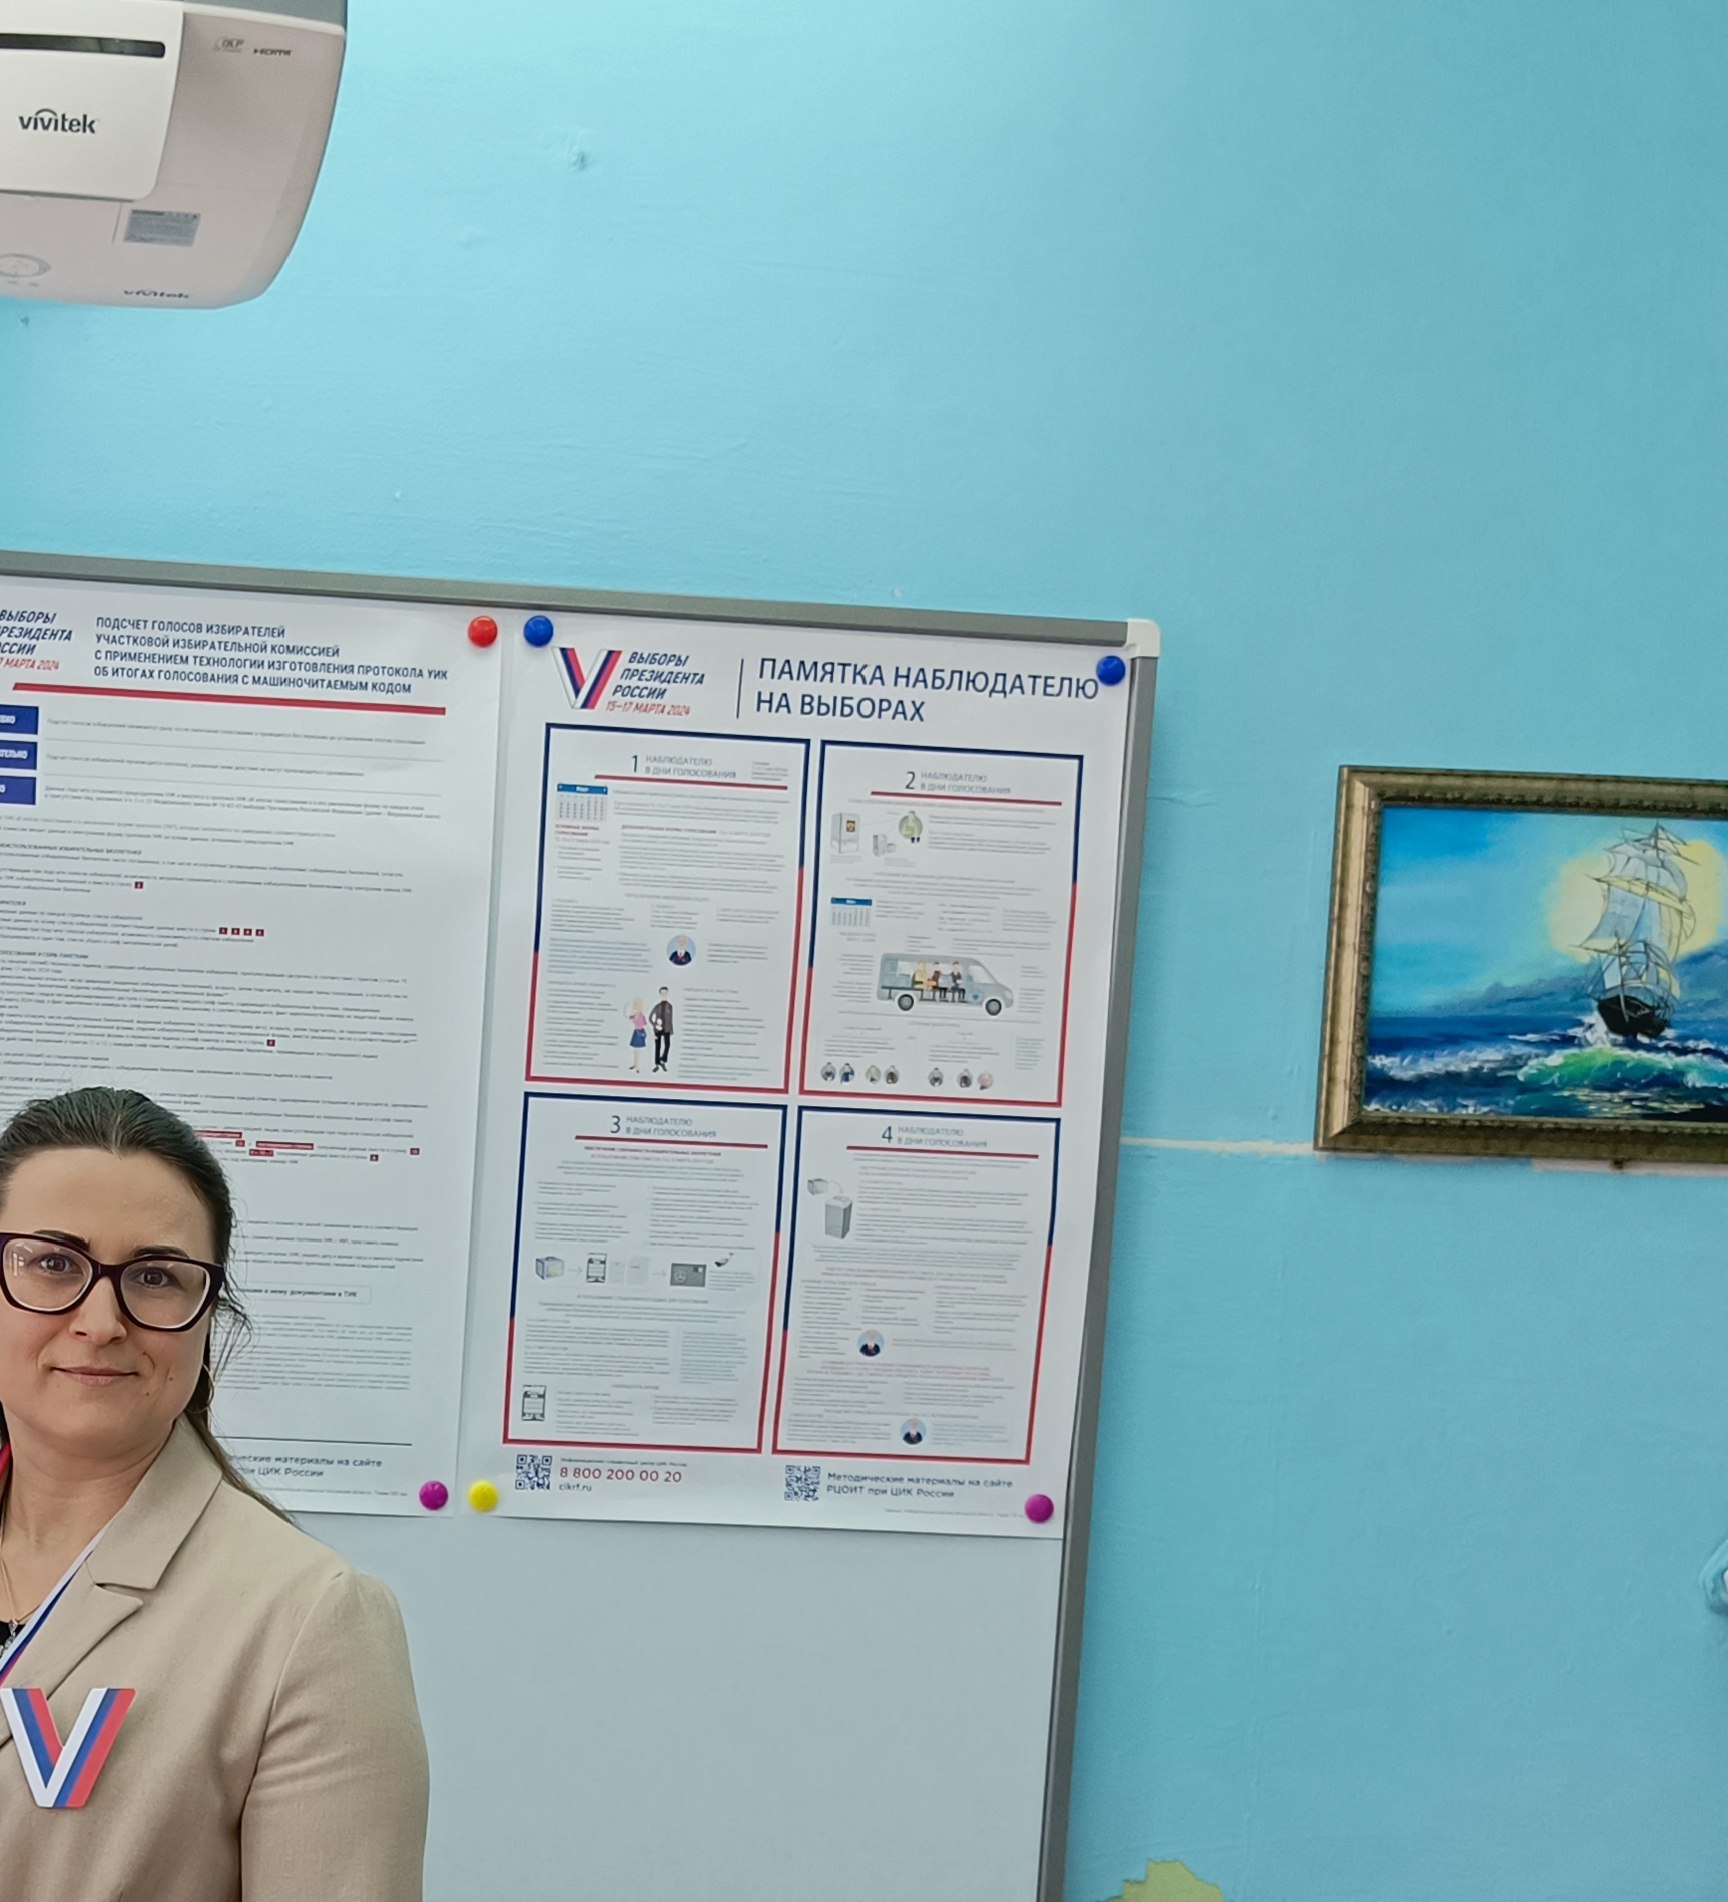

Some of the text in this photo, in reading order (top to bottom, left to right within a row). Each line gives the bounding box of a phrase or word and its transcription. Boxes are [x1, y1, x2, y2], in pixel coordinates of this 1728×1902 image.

[18, 108, 96, 134] vivitek
[96, 616, 285, 638] ПОДСЧЕТ ГОЛОСОВ ИЗБИРАТЕЛЕЙ
[95, 633, 340, 658] УЧАСТКОВОЙ ИЗБИРАТЕЛЬНОЙ КОМИССИЕЙ
[4, 657, 36, 669] МАРТА
[37, 659, 60, 671] 2024
[94, 650, 448, 680] С ПРИМЕНЕНИЕМ ТЕХНОЛОГИИ ИЗГОТОВЛЕНИЯ ПРОТОКОЛА УИК
[628, 651, 689, 667] ВЫБОРЫ
[94, 665, 412, 695] ОБ ИТОГАХ ГОЛОСОВАНИЯ С МАШИНОЧИТАЕМЫМ КОДОМ
[620, 668, 705, 685] ПРЕЗИДЕНТА
[758, 657, 1099, 700] ПАМЯТКА НАБЛЮДАТЕЛЮ
[612, 684, 667, 699] РОССИИ
[633, 703, 665, 714] МАРТА
[667, 704, 690, 716] 2024
[756, 691, 926, 722] НА ВЫБОРАХ
[631, 754, 638, 773] 1
[645, 755, 712, 767] НАБЛЮДАТЕЛЮ
[652, 767, 672, 776] ДНИ
[673, 768, 737, 779] ГОЛОСОВАНИЯ
[905, 771, 916, 790] 2
[921, 771, 987, 783] НАБЛЮДАТЕЛЮ
[948, 784, 1011, 795] ГОЛОСОВАНИЯ
[610, 1115, 621, 1134] 3
[626, 1116, 692, 1127] НАБЛЮДАТЕЛЮ
[653, 1128, 717, 1138] ГОЛОСОВАНИЯ
[881, 1125, 893, 1143] 4
[898, 1126, 964, 1137] НАБЛЮДАТЕЛЮ
[924, 1138, 988, 1148] ГОЛОСОВАНИЯ
[274, 1456, 334, 1466] материалы
[337, 1458, 350, 1466] на
[353, 1457, 382, 1468] сайте
[258, 1467, 281, 1478] ЦИК
[284, 1468, 324, 1477] России
[559, 1467, 683, 1483] 8 800 200 00 20
[559, 1483, 592, 1492] cikrf.ru
[827, 1472, 1013, 1489] Методические материалы на сайте
[827, 1484, 955, 1499] РЦОИТ при ЦИК России
